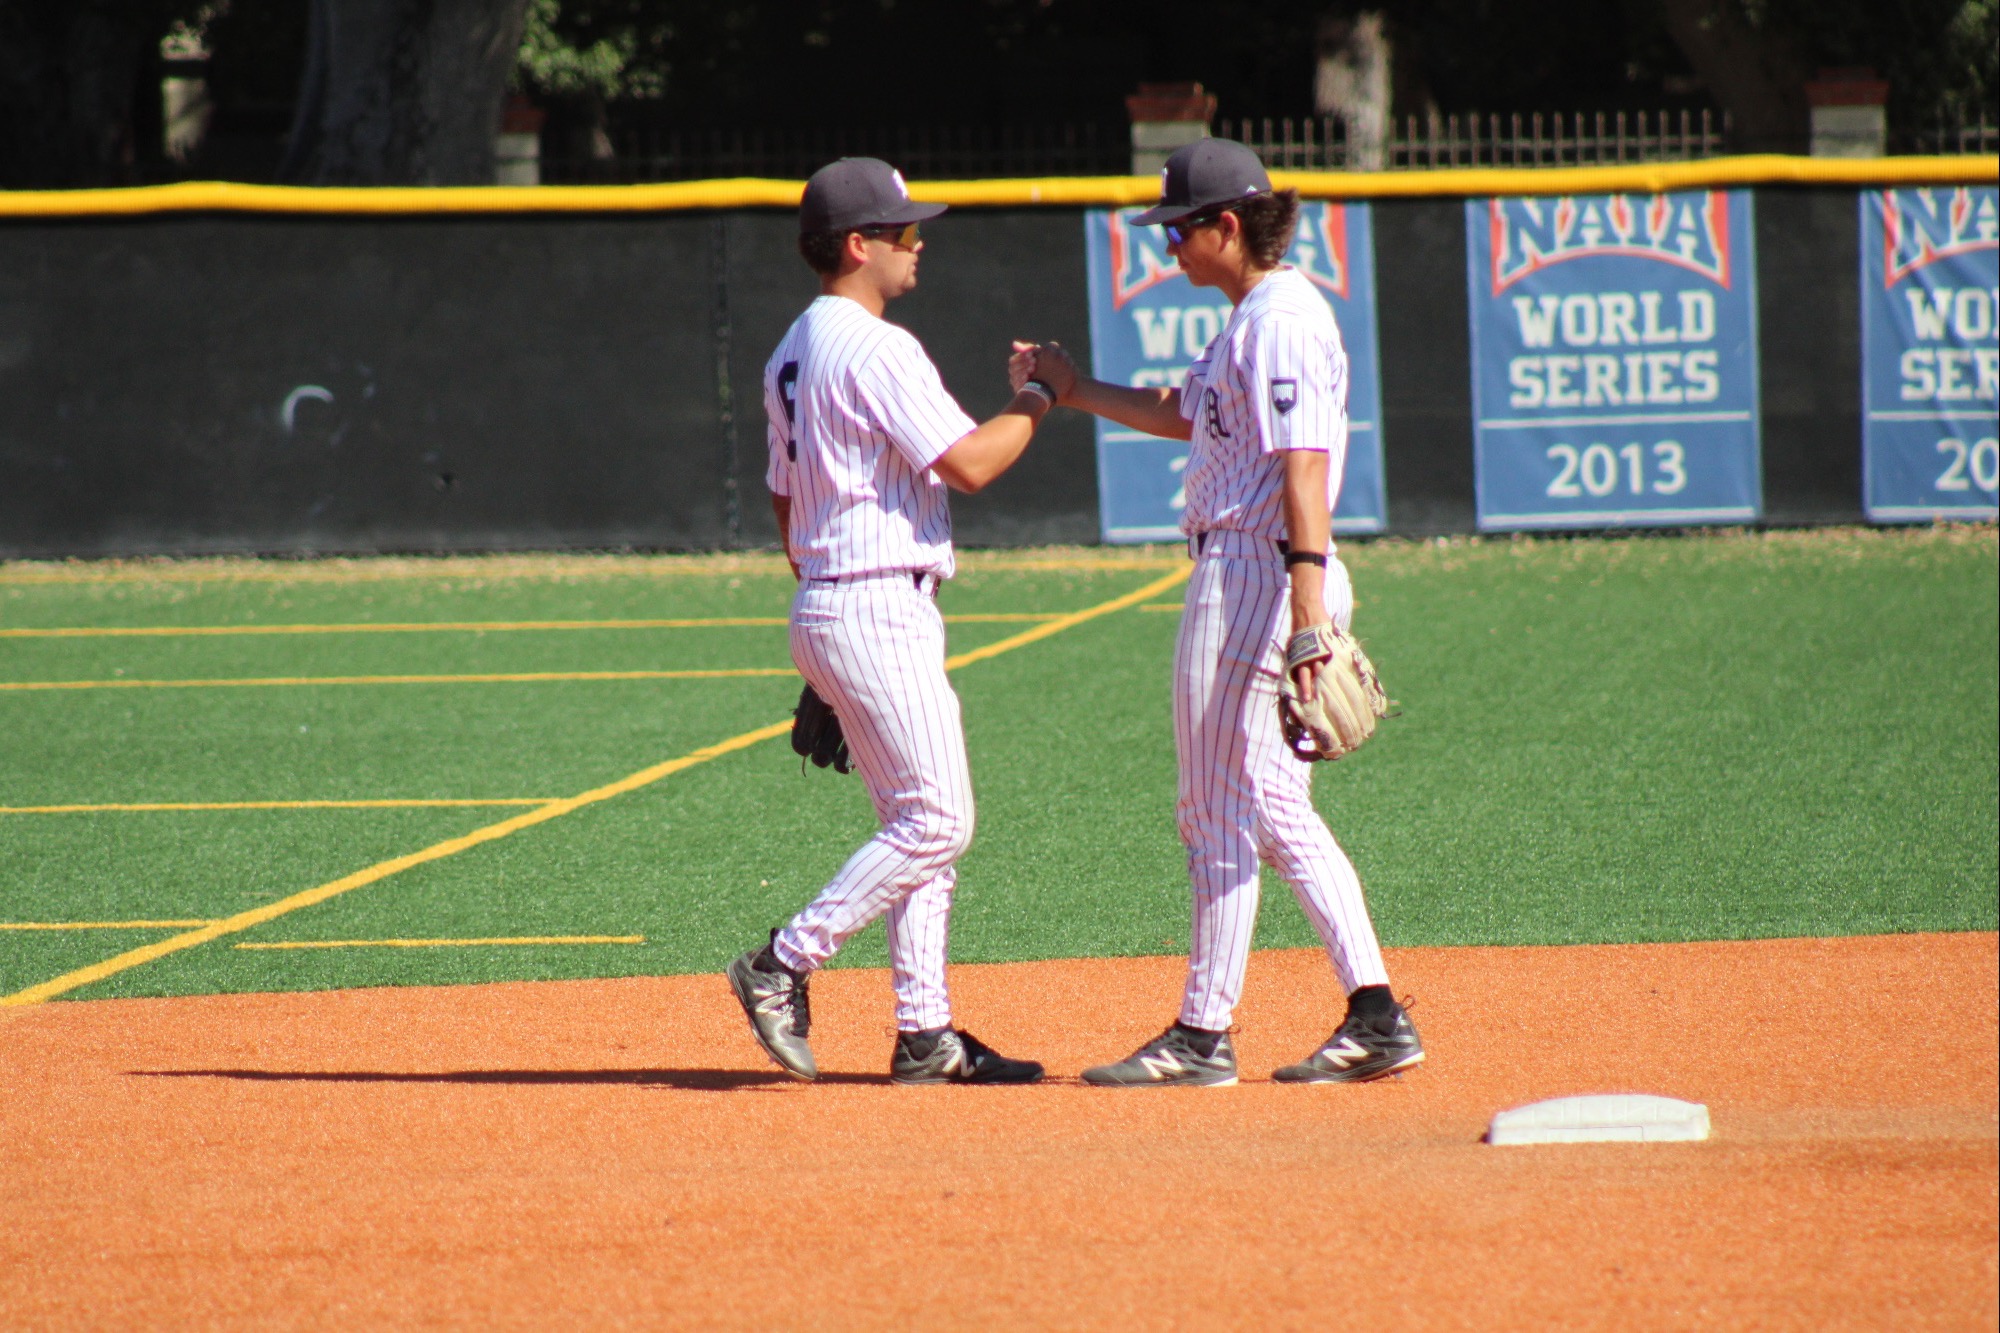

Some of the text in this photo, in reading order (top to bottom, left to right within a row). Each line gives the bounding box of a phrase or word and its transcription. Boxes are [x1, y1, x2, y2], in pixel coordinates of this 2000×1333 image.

[1512, 290, 1716, 347] WORLD
[1510, 350, 1718, 408] SERIES
[1546, 440, 1687, 498] 2013
